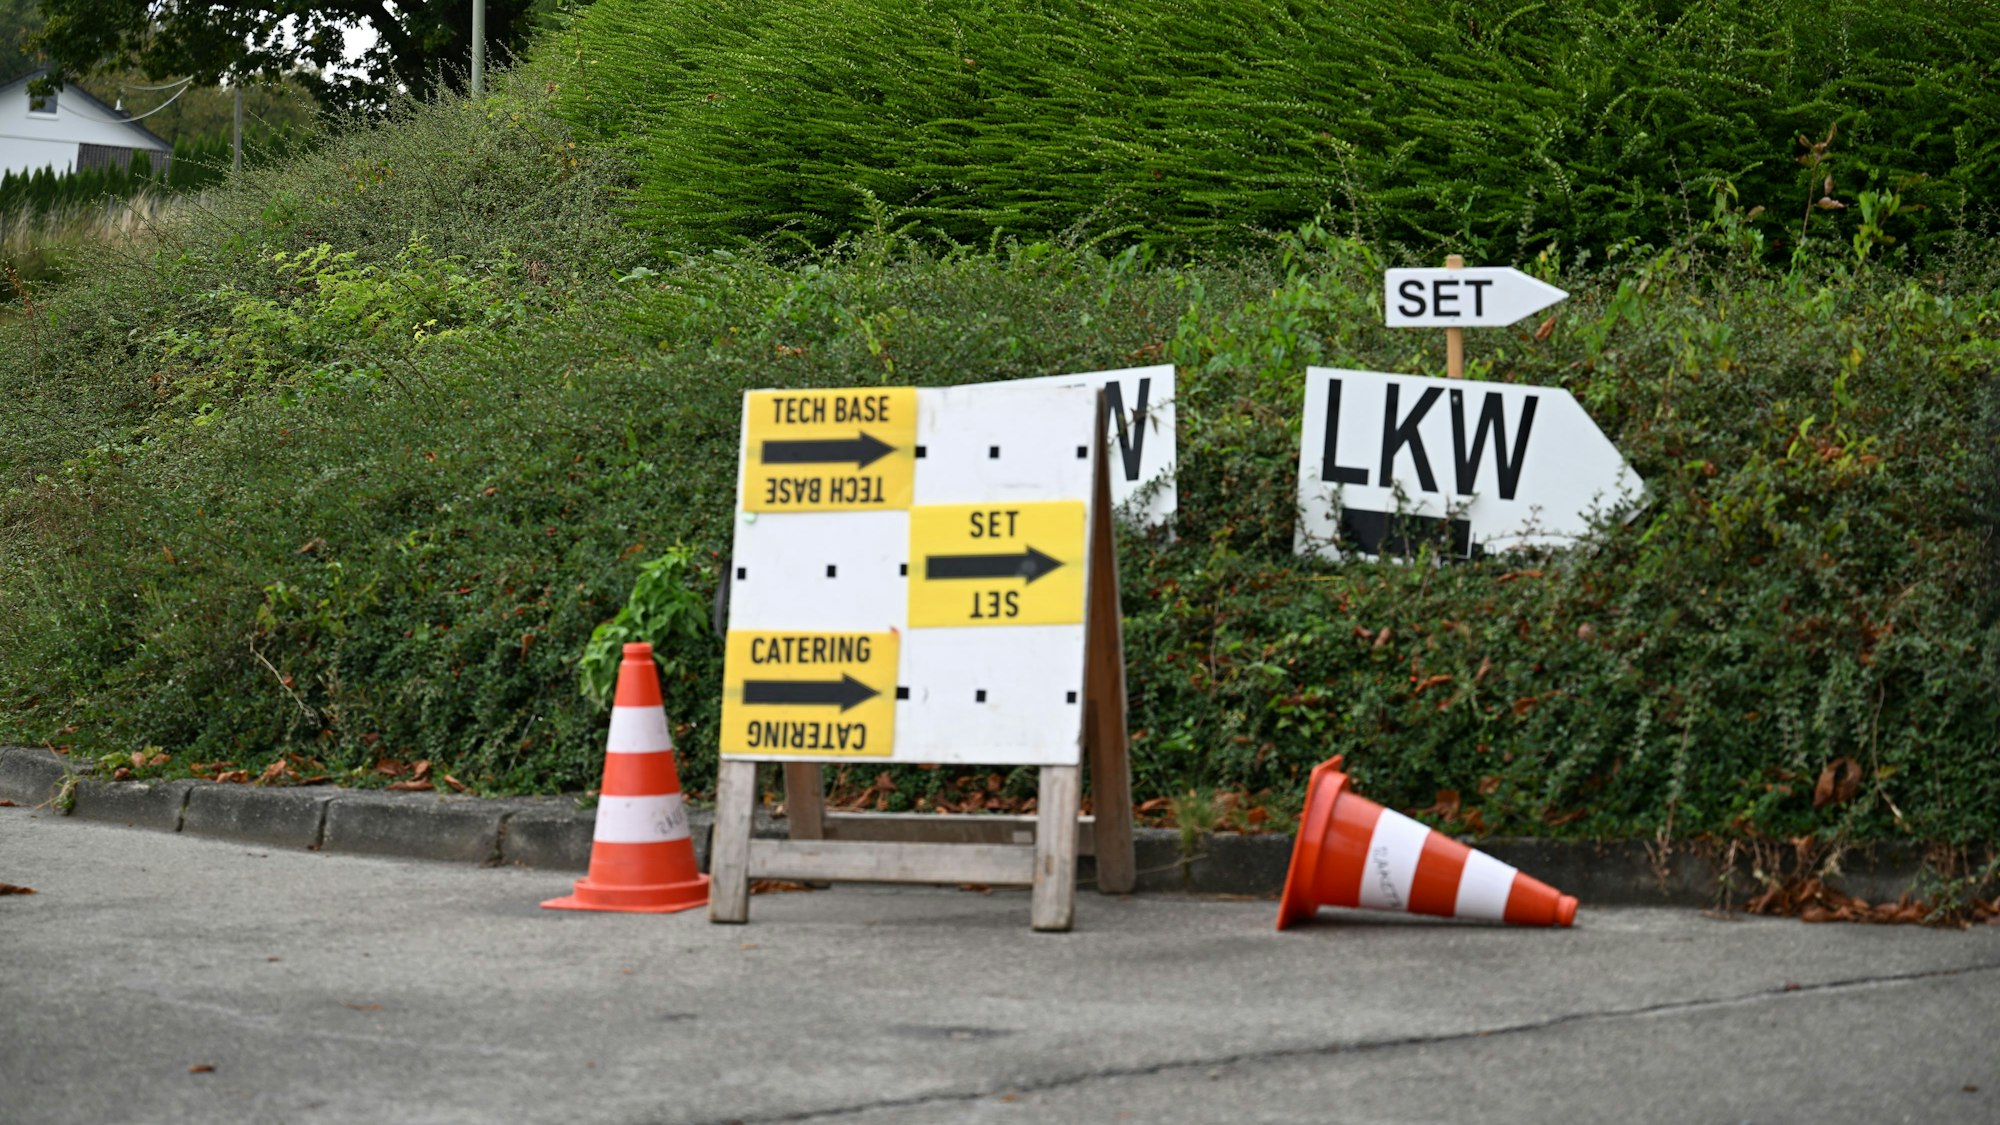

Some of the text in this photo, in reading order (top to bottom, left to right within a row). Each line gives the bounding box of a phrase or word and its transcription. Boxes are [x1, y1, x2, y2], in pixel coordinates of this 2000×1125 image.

[1398, 279, 1493, 318] SET
[773, 396, 889, 424] TECH BASE
[1322, 378, 1539, 500] LKW
[765, 477, 884, 504] TECH BASE
[970, 511, 1019, 538] SET
[970, 591, 1019, 618] SET
[751, 636, 871, 664] CATERING
[747, 721, 867, 750] CATERING
